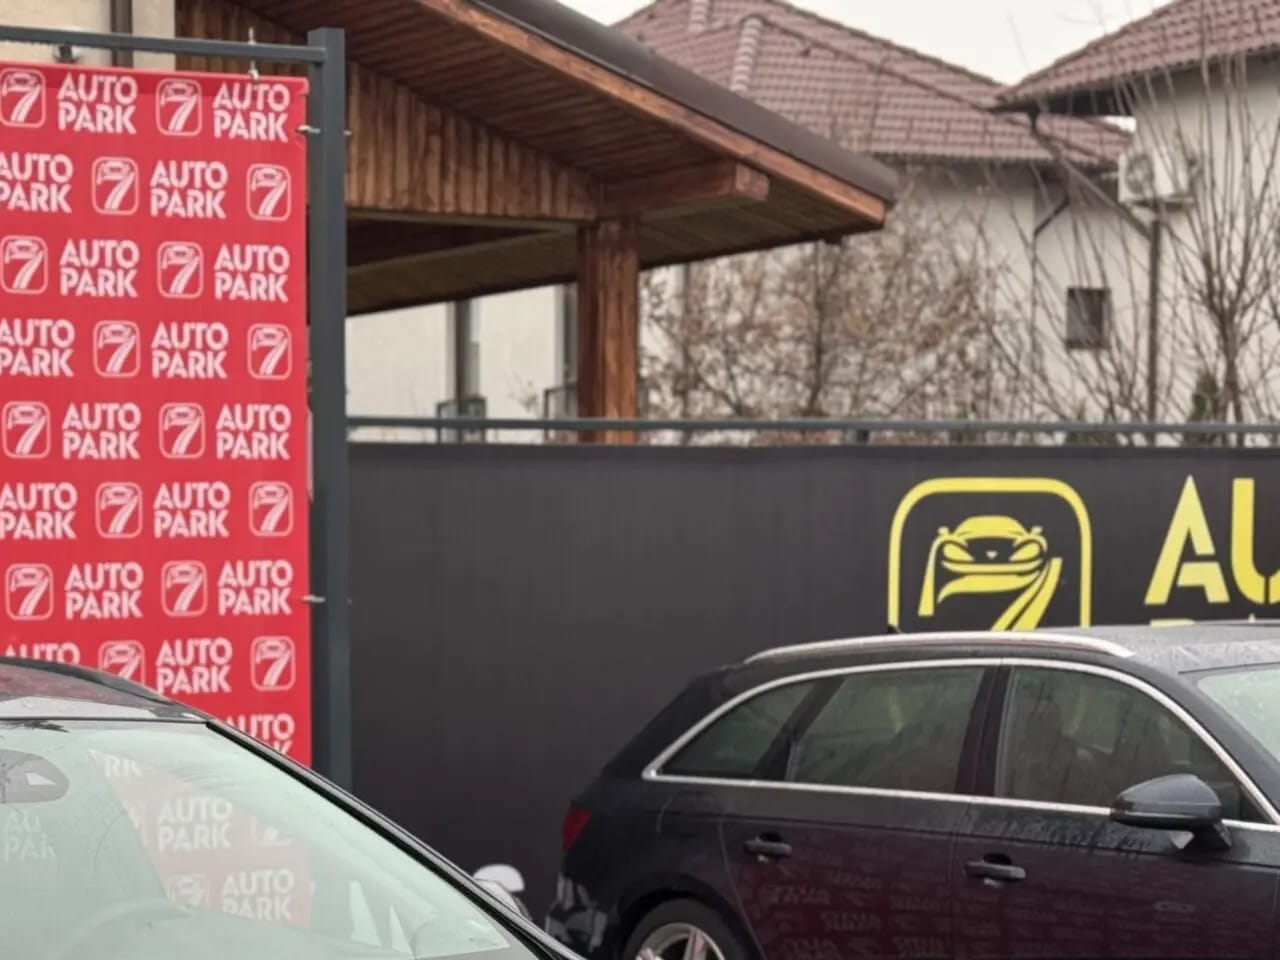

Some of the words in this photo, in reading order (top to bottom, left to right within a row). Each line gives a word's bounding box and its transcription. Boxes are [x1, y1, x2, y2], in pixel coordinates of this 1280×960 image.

[57, 73, 137, 105] AUTO
[212, 82, 290, 113] AUTO
[58, 100, 137, 134] PARK
[213, 109, 288, 142] PARK
[150, 159, 228, 190] AUTO
[150, 187, 226, 219] PARK
[59, 238, 140, 270] AUTO
[214, 243, 290, 274] AUTO
[60, 266, 137, 298] PARK
[215, 271, 289, 302] PARK
[151, 321, 229, 351] AUTO
[152, 349, 227, 379] PARK
[62, 401, 141, 431] AUTO
[215, 402, 292, 433] AUTO
[63, 430, 140, 459] PARK
[216, 431, 290, 459] PARK
[153, 480, 231, 512] AUTO
[154, 509, 229, 538] PARK
[65, 561, 144, 591] AUTO
[218, 558, 293, 589] AUTO
[65, 588, 142, 619] PARK
[218, 585, 291, 615] PARK
[156, 636, 233, 667] AUTO
[156, 664, 231, 694] PARK
[226, 712, 295, 741] UTO
